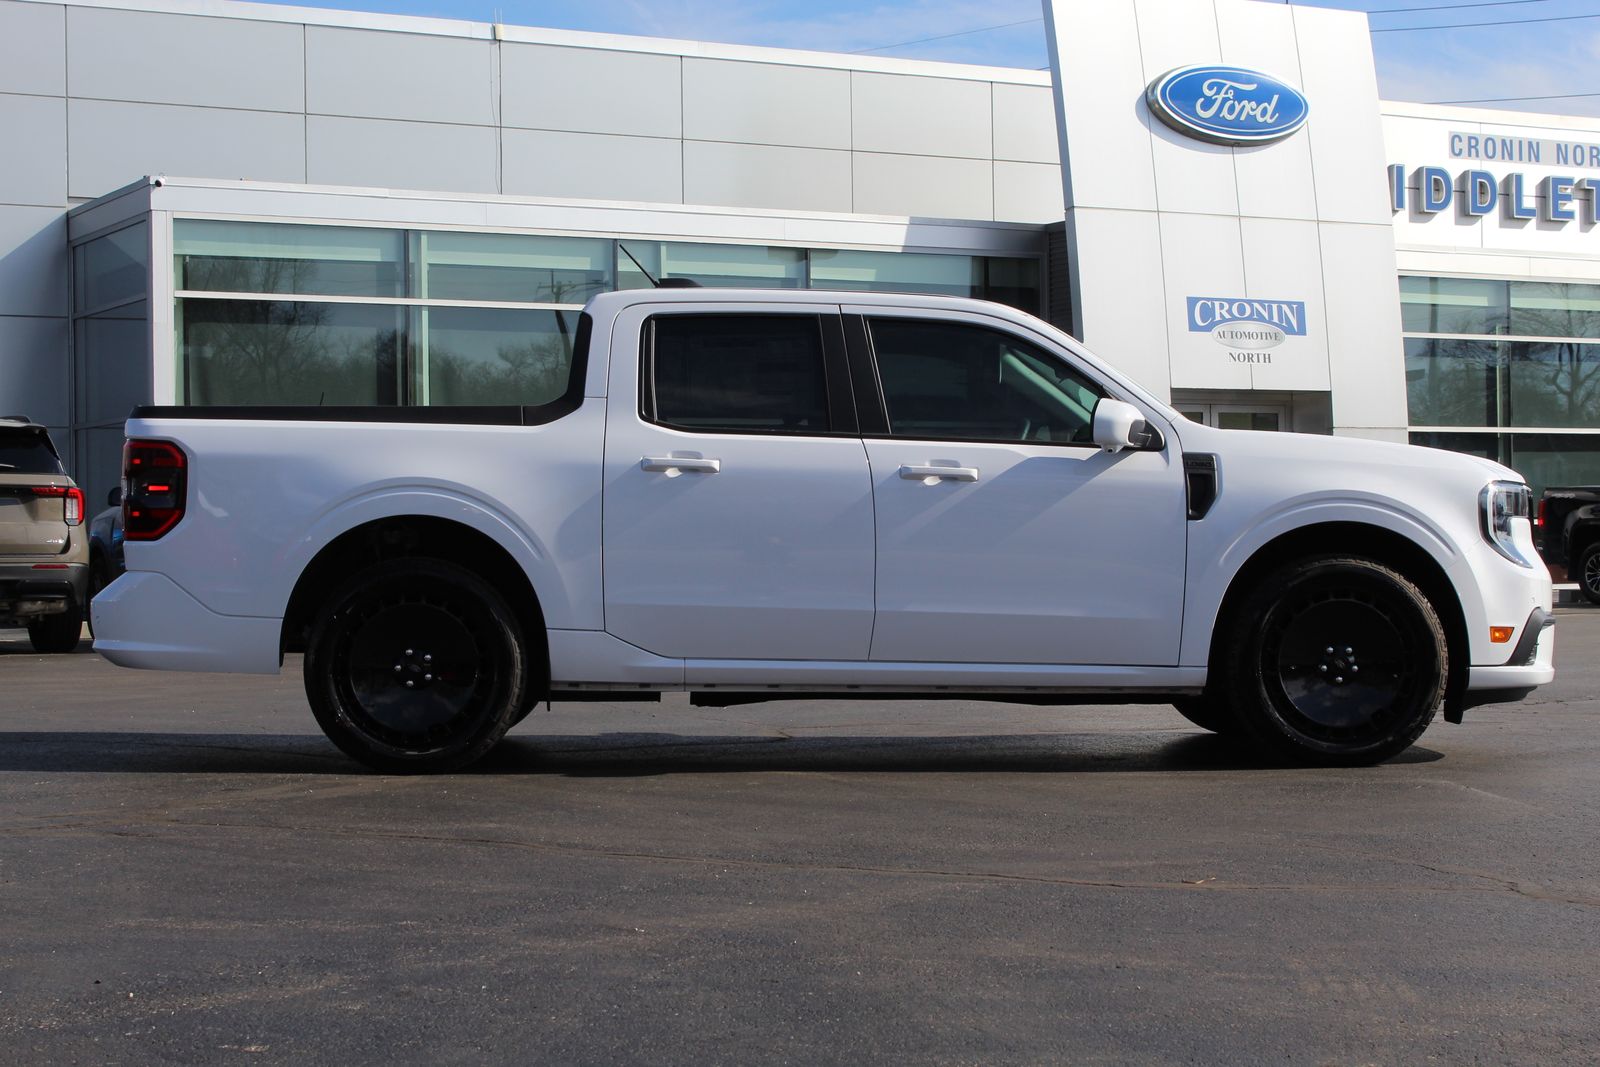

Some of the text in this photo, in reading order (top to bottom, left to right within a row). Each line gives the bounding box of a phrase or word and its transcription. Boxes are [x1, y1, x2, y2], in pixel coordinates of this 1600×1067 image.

[1195, 78, 1280, 124] Ford
[1450, 134, 1600, 168] CRONIN NOR
[1194, 299, 1298, 332] CRONIN
[1216, 330, 1281, 341] AUTOMOTIVE
[1228, 352, 1272, 364] NORTH
